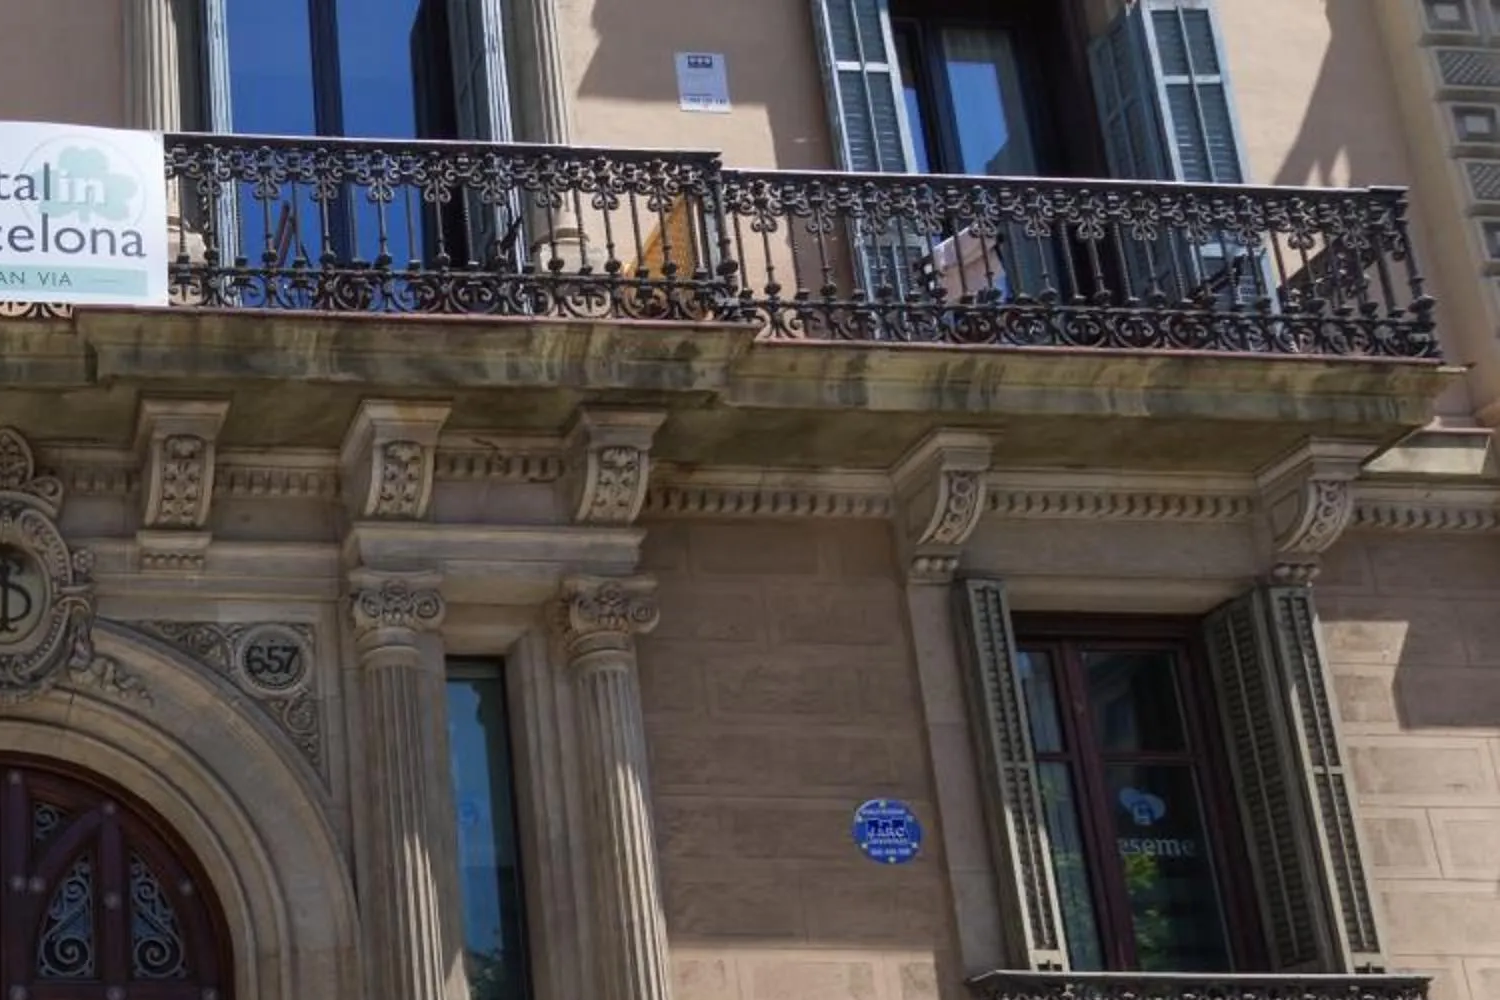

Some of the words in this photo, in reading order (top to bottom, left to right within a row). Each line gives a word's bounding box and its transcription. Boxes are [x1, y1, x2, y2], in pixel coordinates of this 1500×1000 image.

[58, 170, 106, 204] in
[37, 271, 73, 287] VIA
[246, 644, 299, 674] 657
